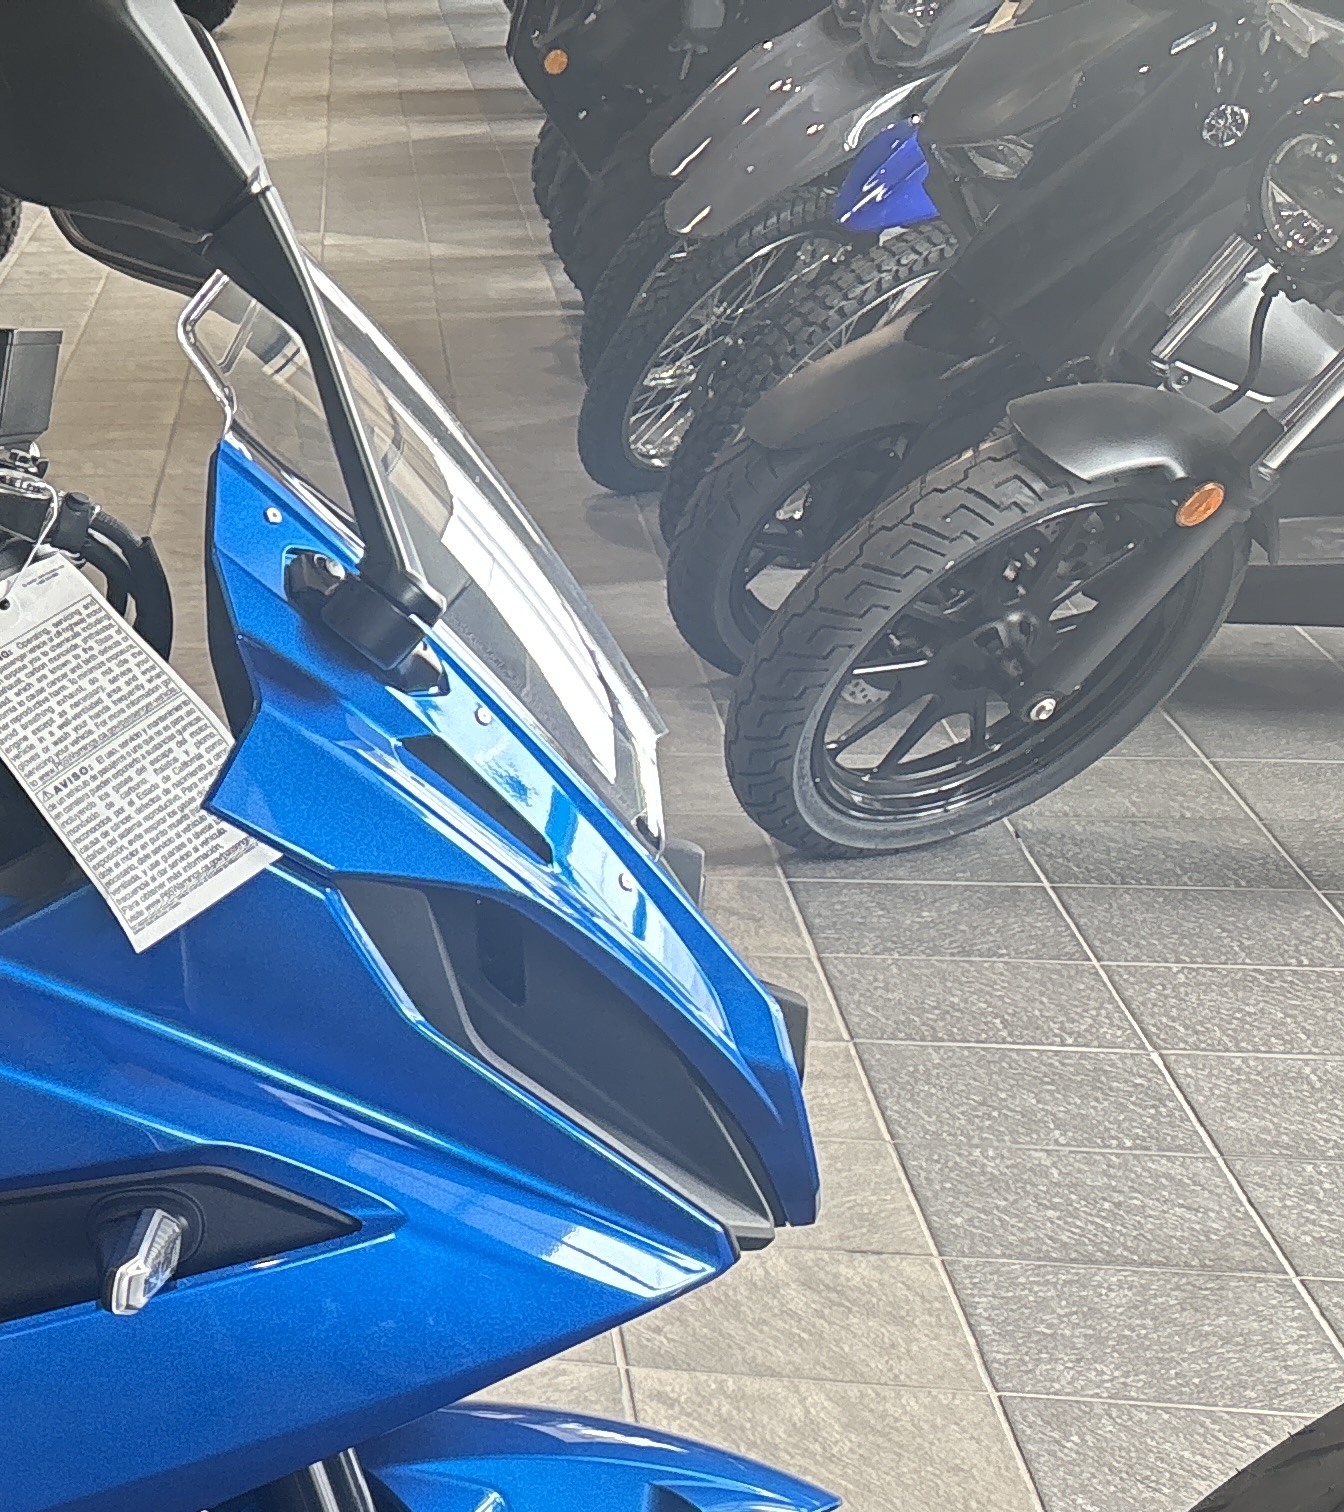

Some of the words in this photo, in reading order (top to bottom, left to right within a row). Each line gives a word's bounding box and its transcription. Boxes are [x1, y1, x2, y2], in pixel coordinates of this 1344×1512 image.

[27, 655, 43, 667] you
[39, 648, 50, 658] to
[12, 680, 35, 698] which
[71, 651, 83, 661] to
[80, 644, 96, 655] the
[86, 675, 100, 686] do
[99, 666, 115, 678] not
[123, 674, 139, 687] and
[15, 698, 27, 708] to
[48, 729, 72, 748] wash
[71, 719, 91, 735] your
[52, 744, 72, 760] your
[93, 718, 109, 731] For
[107, 707, 127, 723] more
[50, 761, 94, 794] AVISO:
